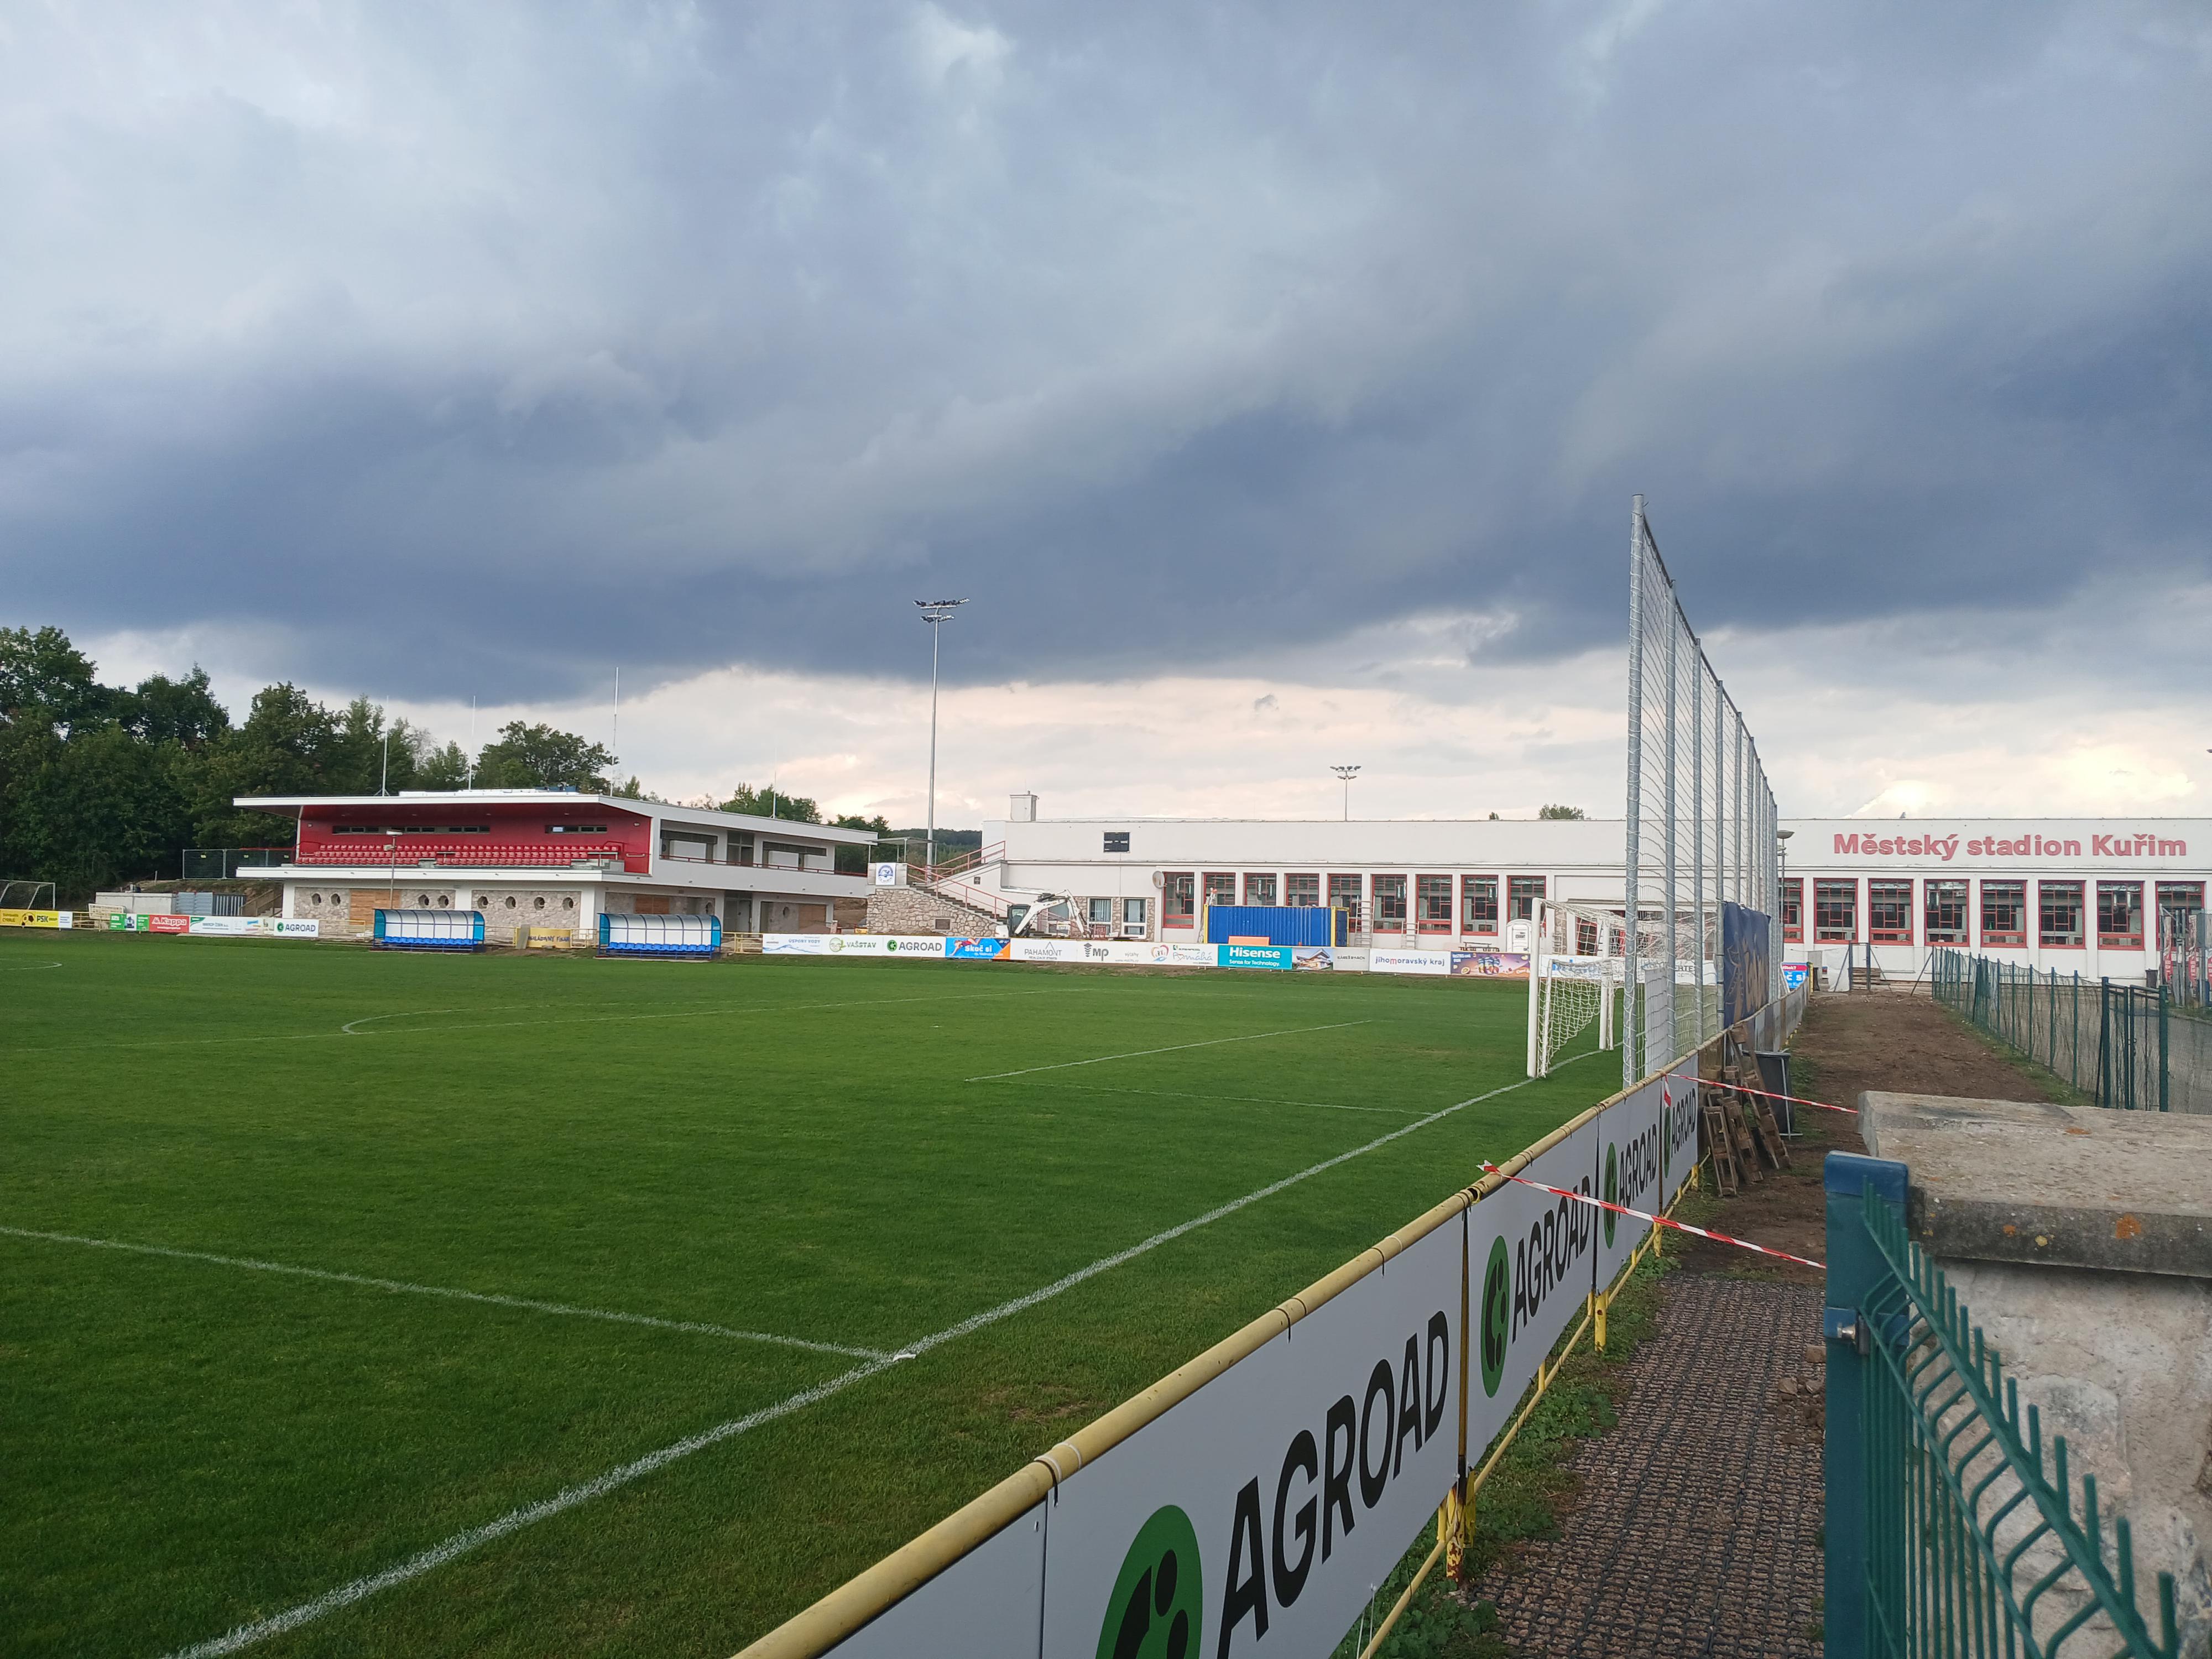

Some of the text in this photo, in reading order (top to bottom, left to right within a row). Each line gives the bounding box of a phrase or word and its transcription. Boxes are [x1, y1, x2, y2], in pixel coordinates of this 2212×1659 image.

[1834, 833, 2187, 860] Městský stadion Kuřim
[161, 917, 187, 926] Kappa
[899, 942, 942, 951] AGROAD
[985, 945, 992, 953] si
[1024, 947, 1062, 956] PAHAMONT
[1229, 947, 1281, 958] Hisense
[1375, 956, 1427, 966] jihomoravský
[1430, 958, 1445, 966] kraj
[1671, 1087, 1696, 1159] AGROAD
[1618, 1123, 1658, 1220] AGROAD
[1512, 1175, 1590, 1344] AGROAD
[1218, 1310, 1449, 1659] AGROAD
